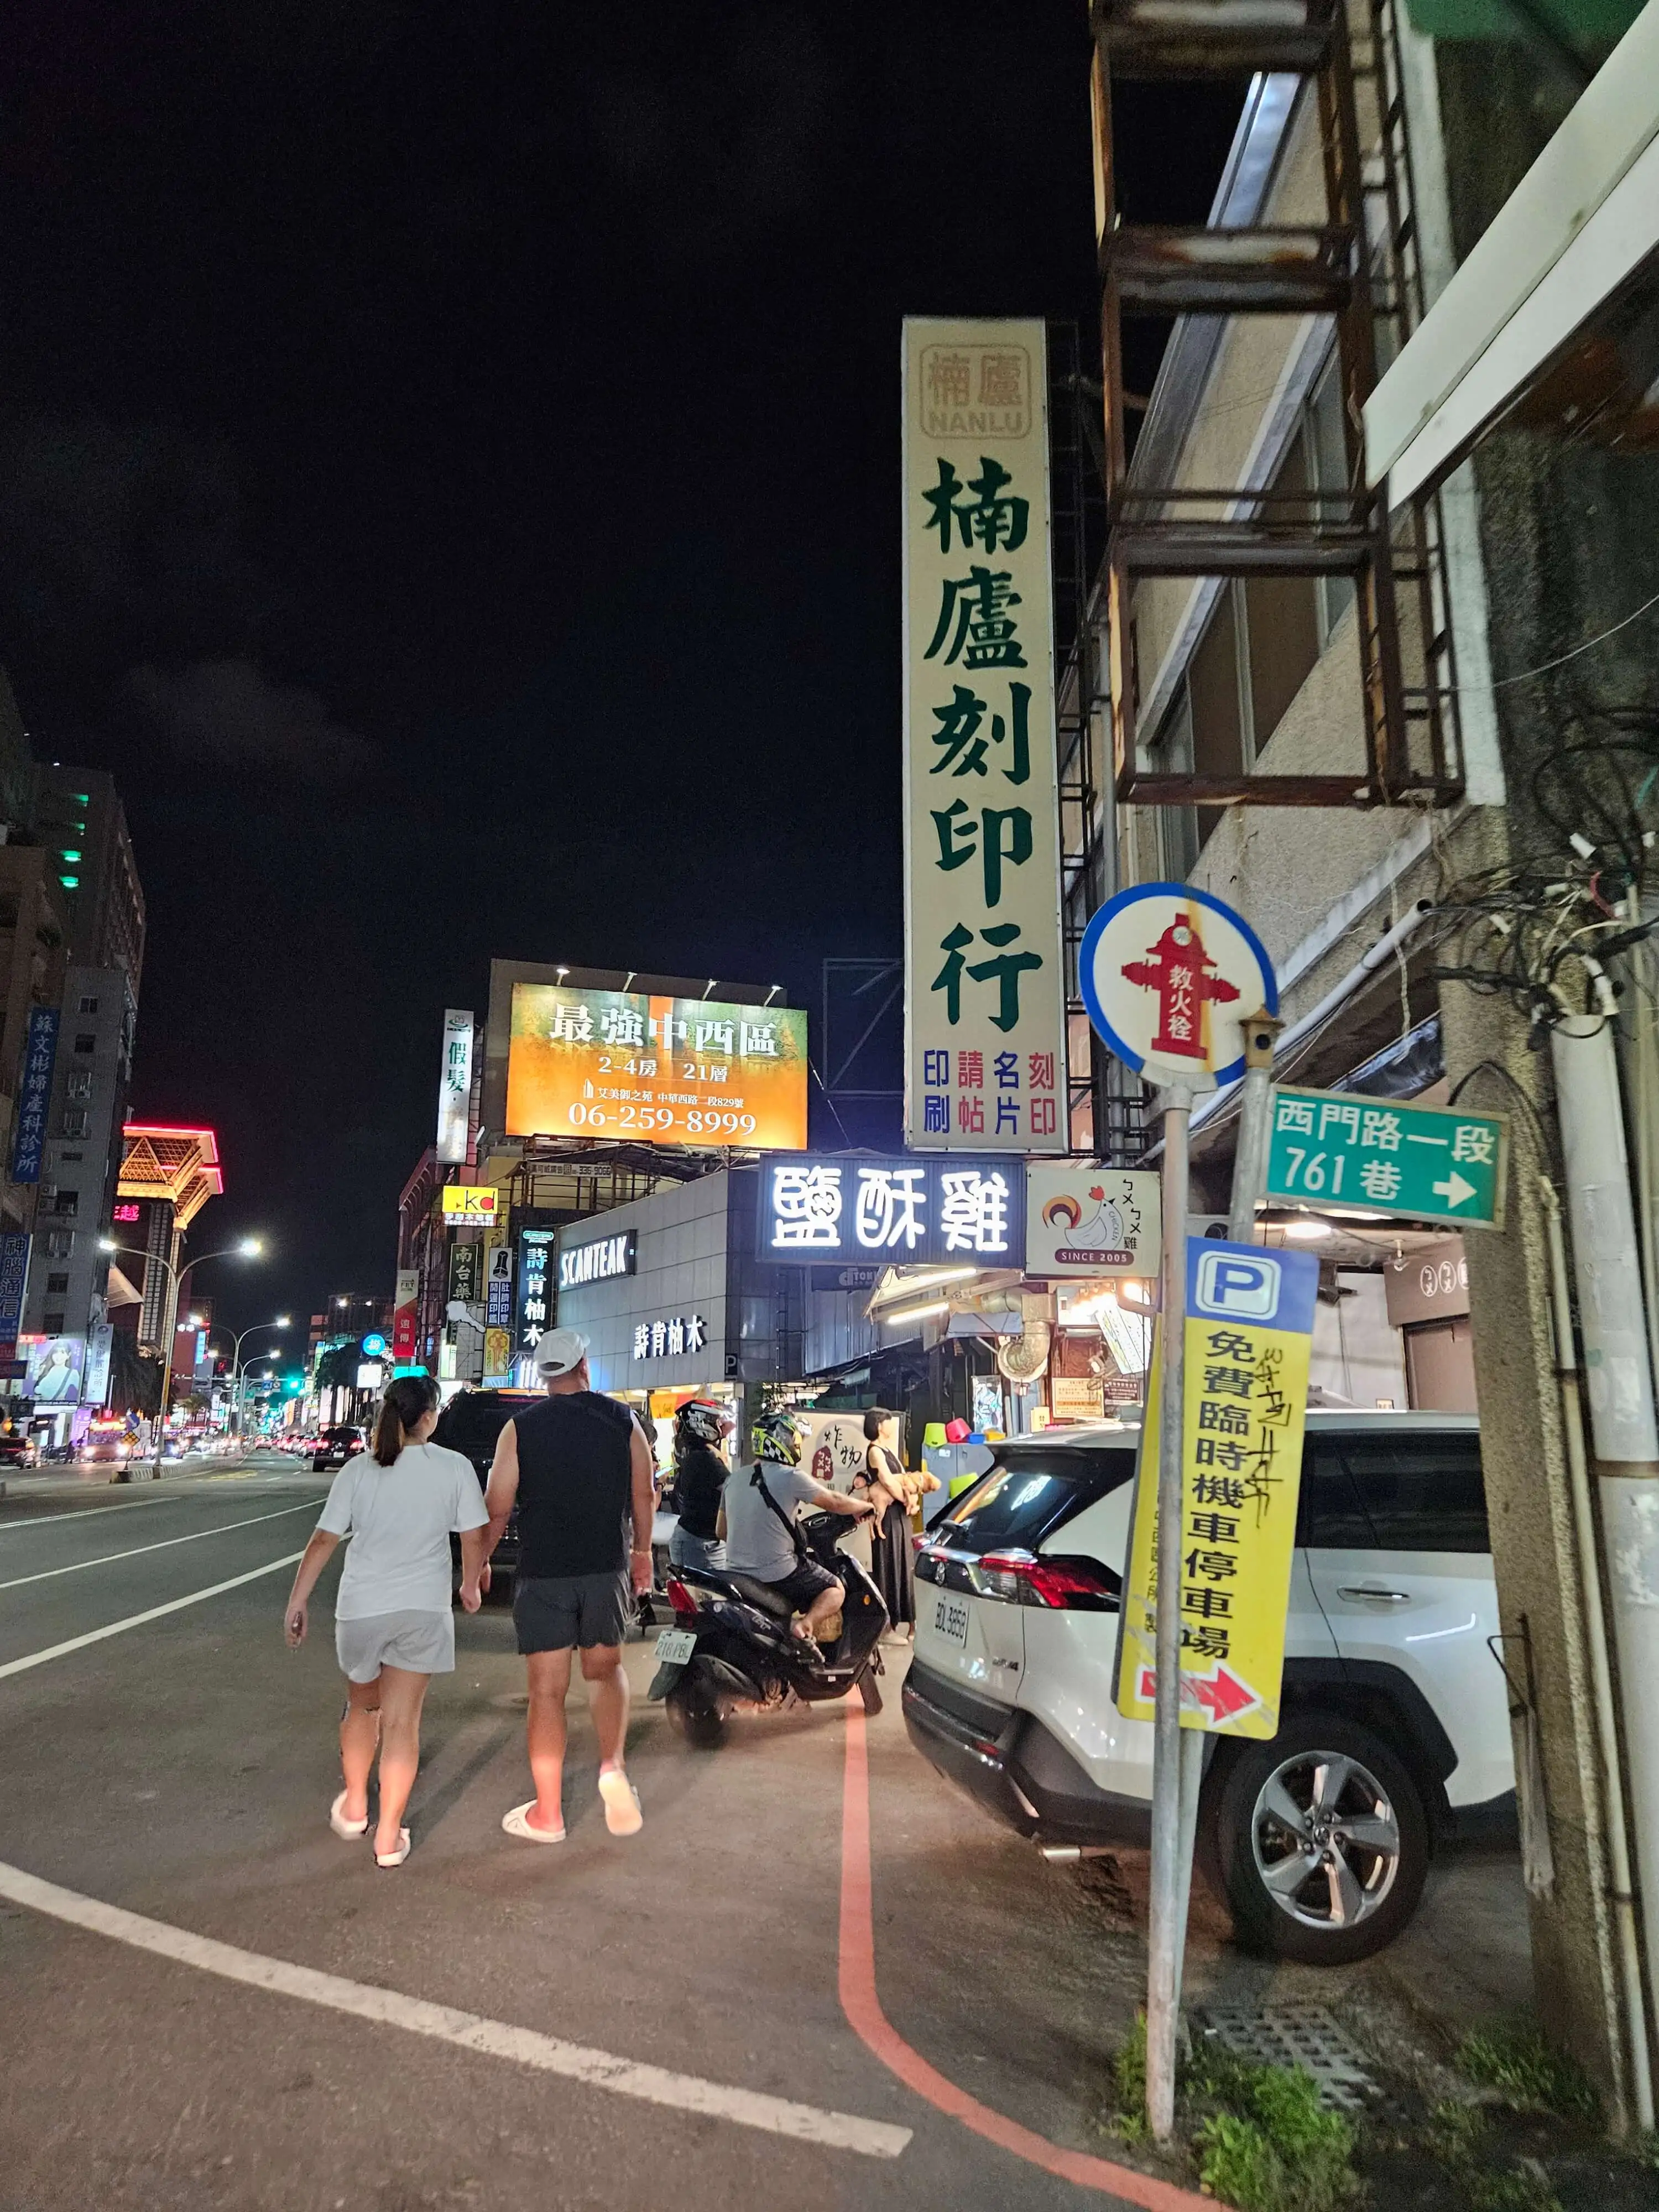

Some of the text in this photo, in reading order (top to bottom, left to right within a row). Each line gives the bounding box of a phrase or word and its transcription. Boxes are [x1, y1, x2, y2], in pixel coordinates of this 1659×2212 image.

[929, 415, 1023, 433] NANLU
[922, 456, 1043, 1032] 楠廬刻印行
[549, 1003, 779, 1056] 最強中西區
[1168, 964, 1194, 1041] 救火栓
[446, 1042, 467, 1092] 假髮
[598, 1056, 728, 1083] 2-4房 21層
[923, 1050, 950, 1135] 印刷
[958, 1050, 985, 1135] 請帖
[994, 1051, 1020, 1136] 名片
[1028, 1052, 1056, 1136] 刻印
[568, 1102, 756, 1136] 06-259-8999
[1276, 1099, 1495, 1165] 西門路一段
[771, 1166, 1009, 1251] 鹽酥雞
[0, 1237, 27, 1318] 神腦通信
[561, 1236, 628, 1286] SCANTEAK
[1061, 1252, 1127, 1262] SINCE 2005
[1213, 1261, 1264, 1304] P
[523, 1248, 548, 1347] 詩肯柚木
[634, 1314, 703, 1359] 詩肯柚木
[1180, 1331, 1256, 1661] 免費臨時機車停車場
